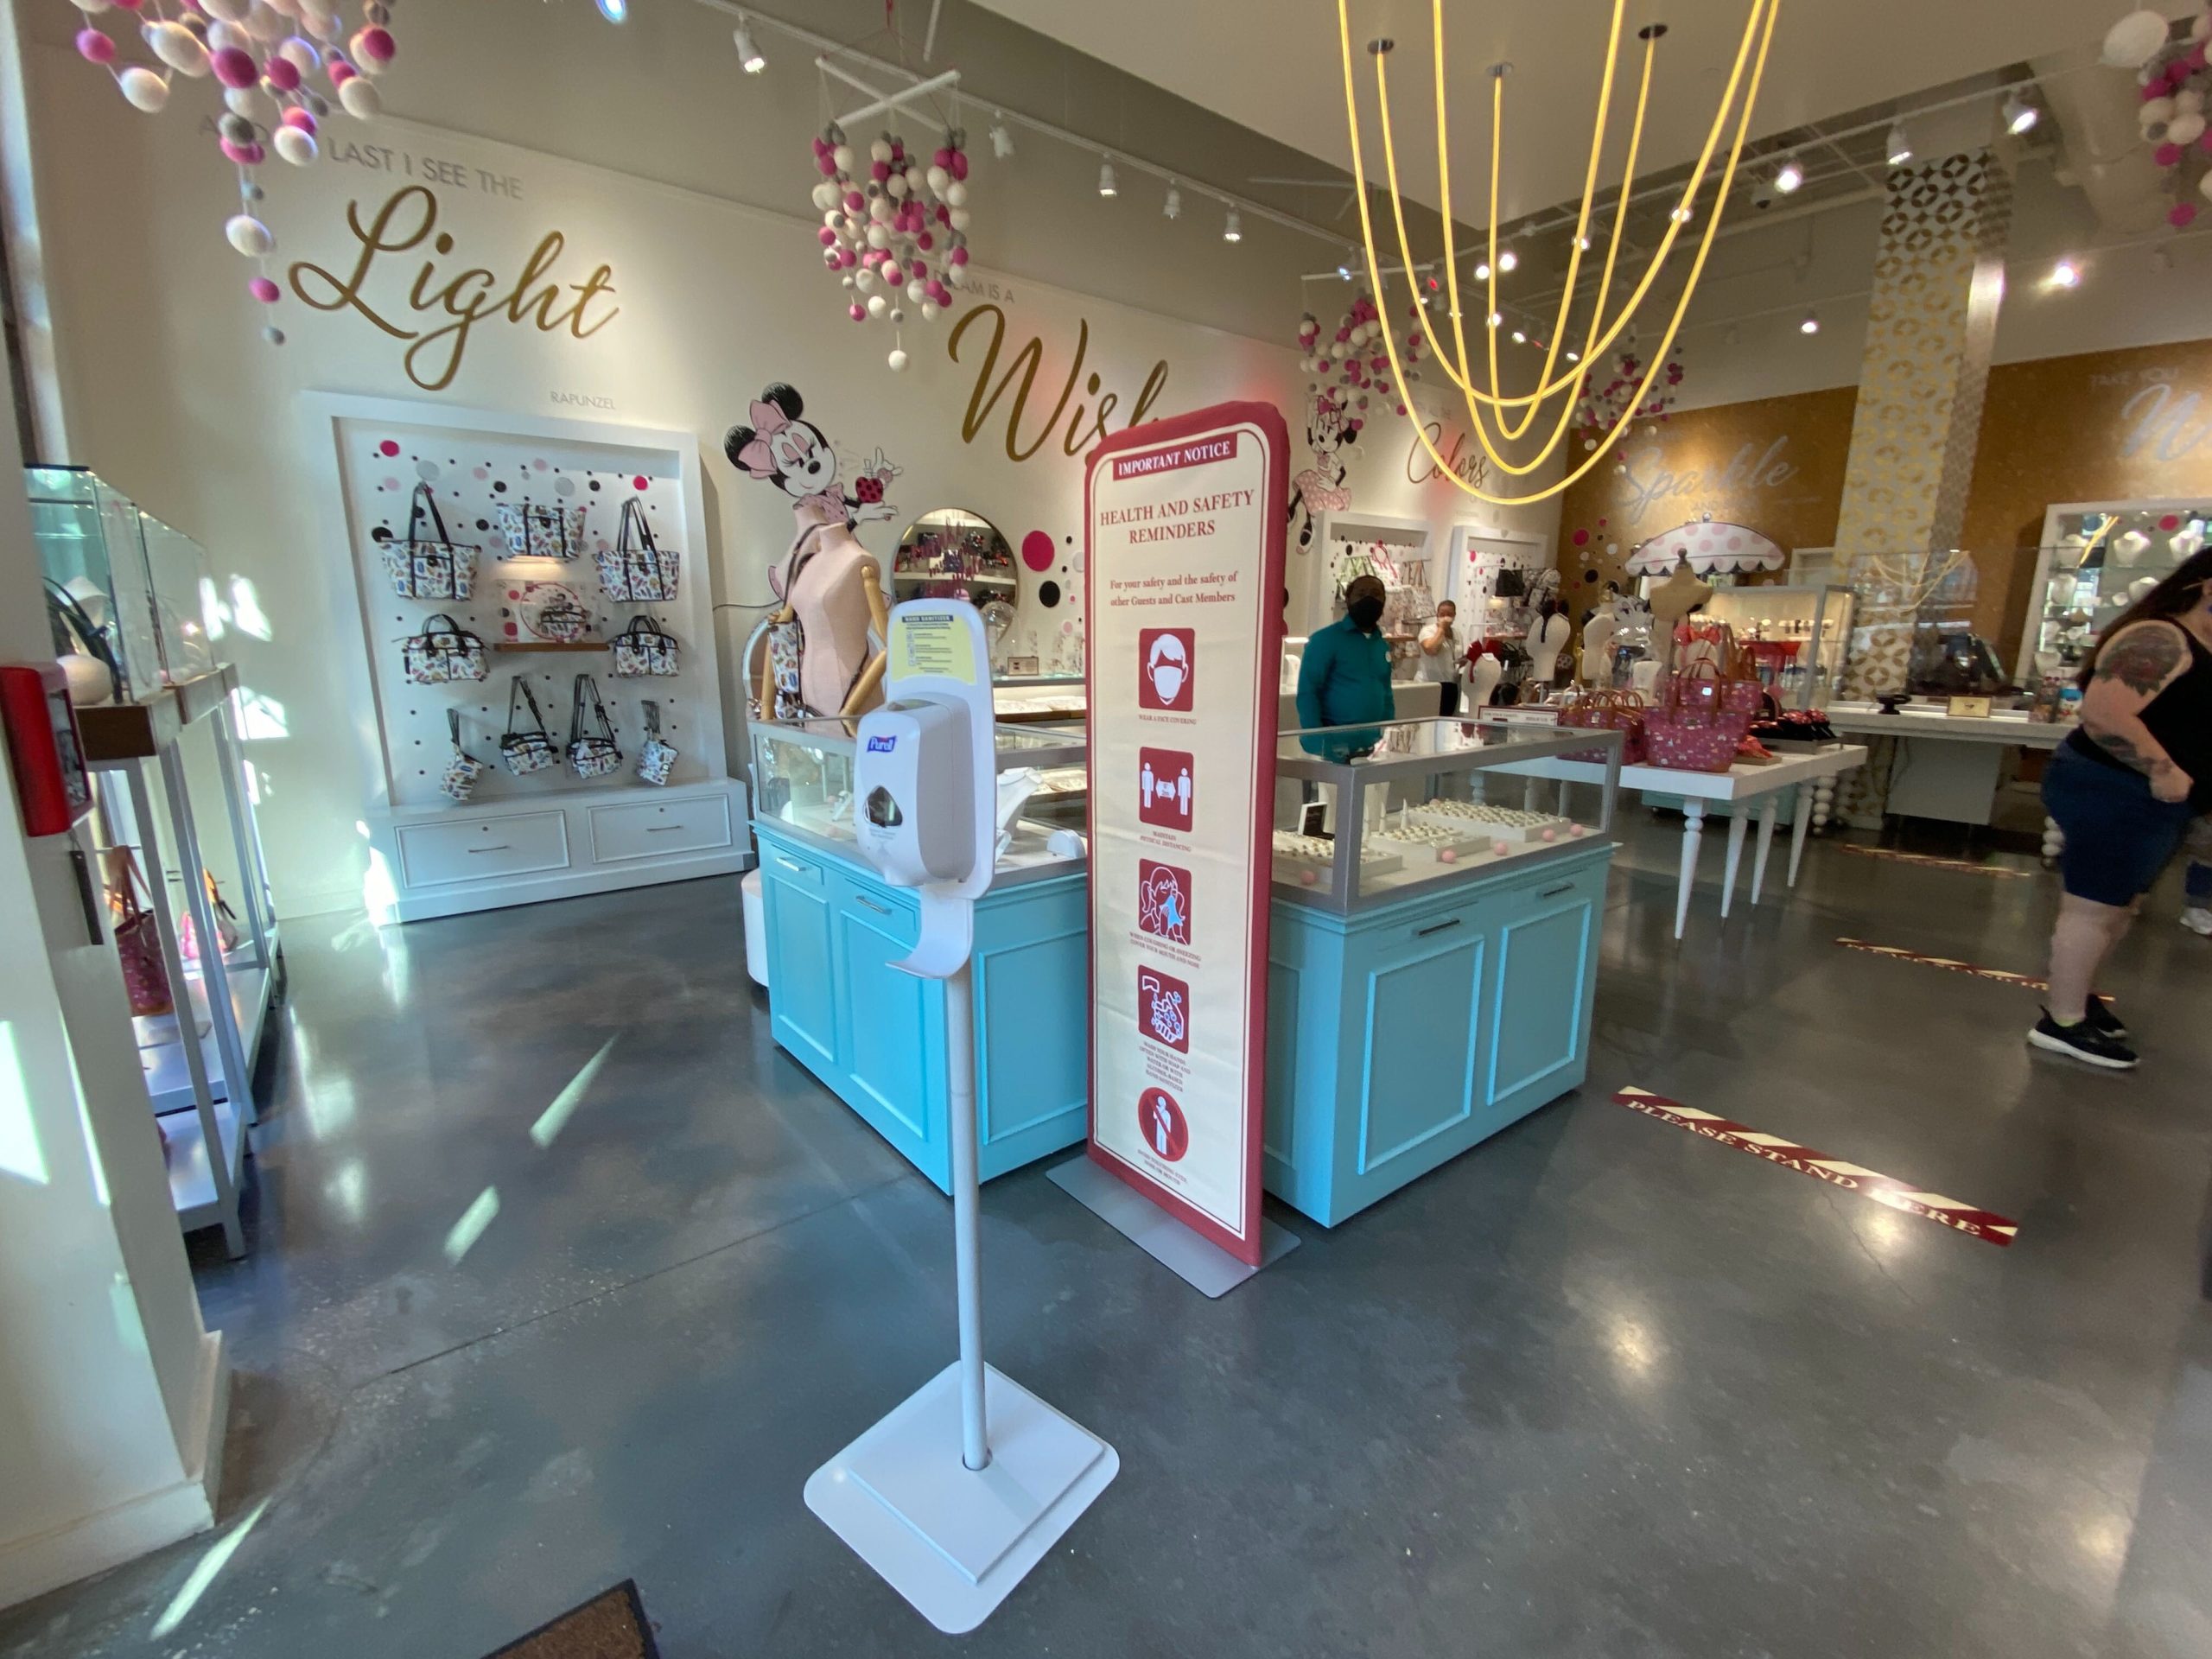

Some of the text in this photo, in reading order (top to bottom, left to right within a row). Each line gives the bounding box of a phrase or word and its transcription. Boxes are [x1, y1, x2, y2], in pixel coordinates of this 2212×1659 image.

[327, 137, 394, 172] LAST
[404, 151, 413, 175] I
[421, 156, 467, 188] SEE
[475, 168, 524, 200] THE
[288, 184, 620, 391] Light
[988, 283, 1001, 301] IS
[1004, 289, 1015, 303] A
[550, 391, 616, 410] RAPUNZEL
[1118, 441, 1231, 476] IMPORTANT NOTICE
[1407, 421, 1490, 489] Colors
[1618, 435, 1800, 524] Sparkle
[1100, 489, 1255, 526] HEALTH AND SAFETY
[1129, 519, 1216, 543] REMINDERS
[1110, 570, 1238, 592] For your safety and the safety of
[1110, 591, 1236, 607] other Guests and Cast Members
[1625, 1099, 1738, 1146] PLEASE
[1743, 1142, 1859, 1189] STAND
